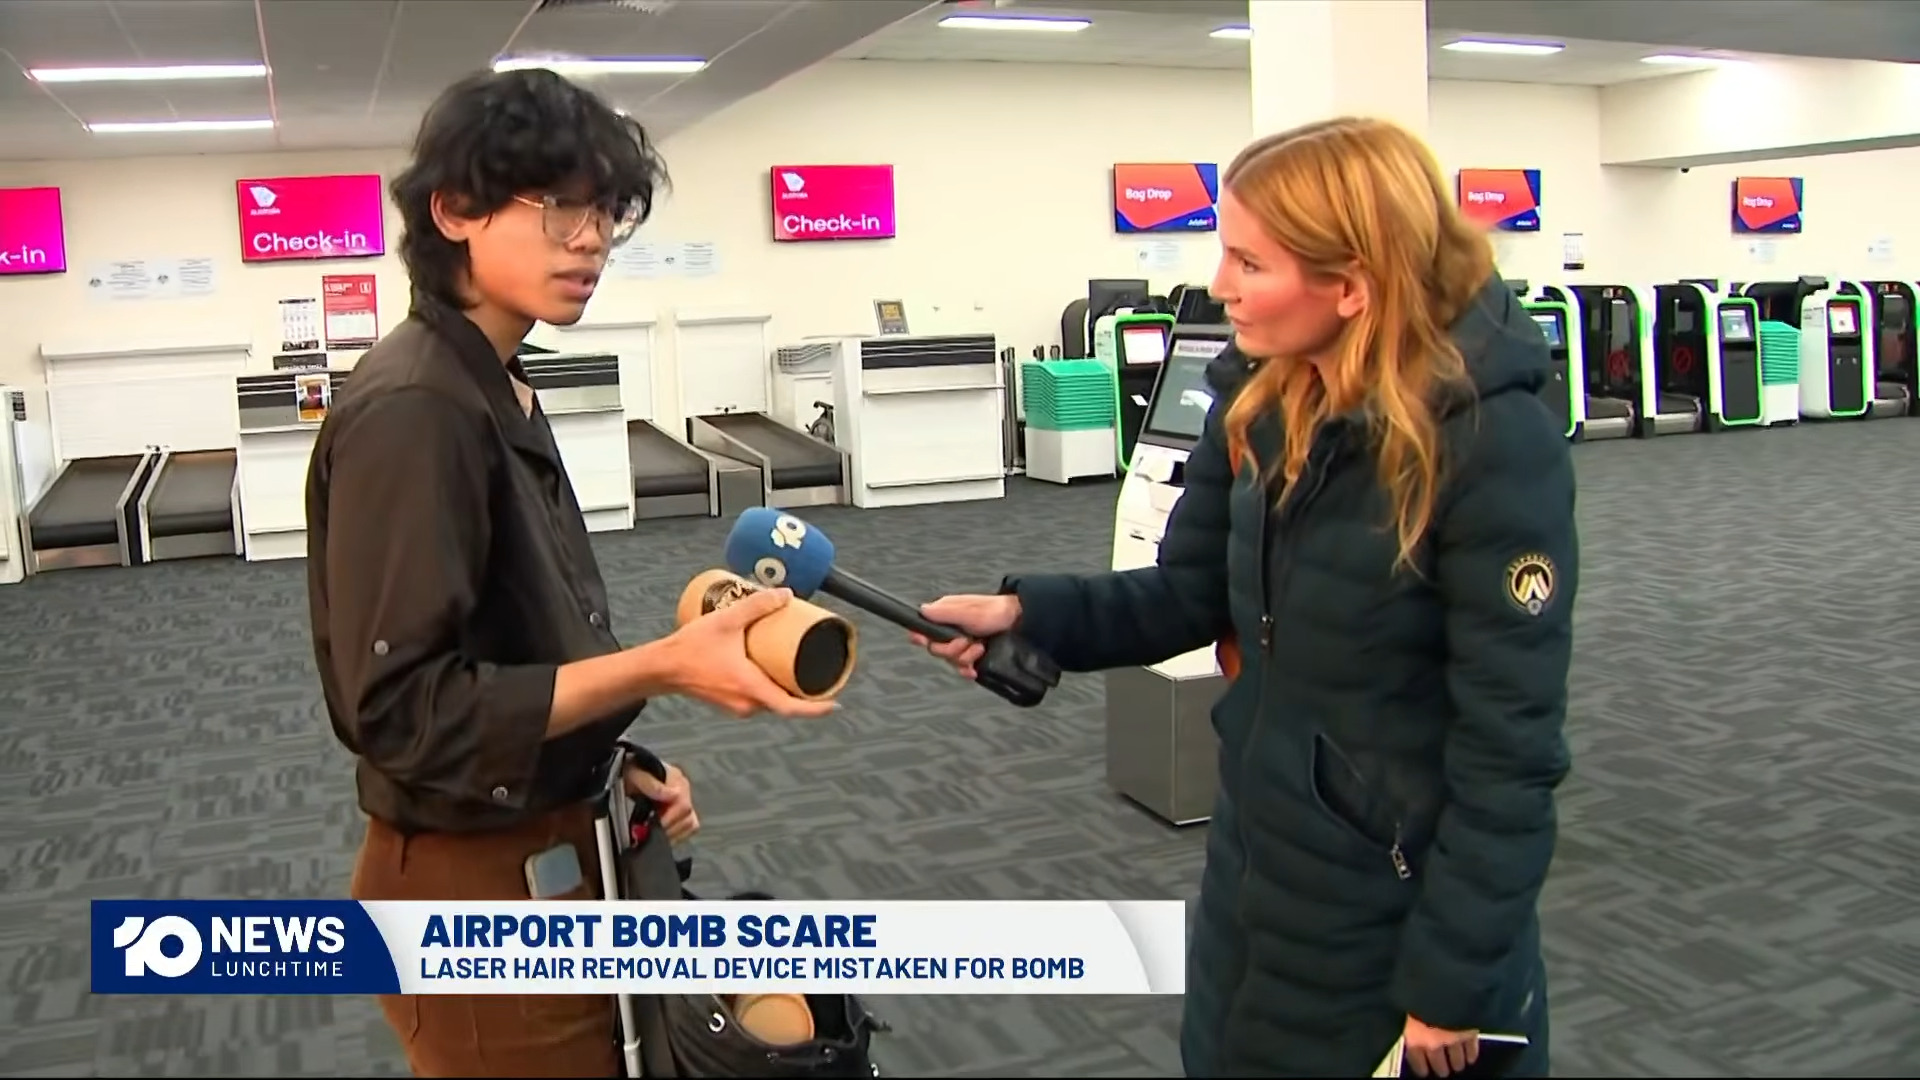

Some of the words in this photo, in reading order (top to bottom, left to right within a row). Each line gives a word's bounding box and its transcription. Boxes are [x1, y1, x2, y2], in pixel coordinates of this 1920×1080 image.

[1125, 188, 1146, 202] Bag
[1147, 188, 1172, 201] Drop
[783, 212, 880, 234] Check-in
[252, 229, 366, 253] Check-in
